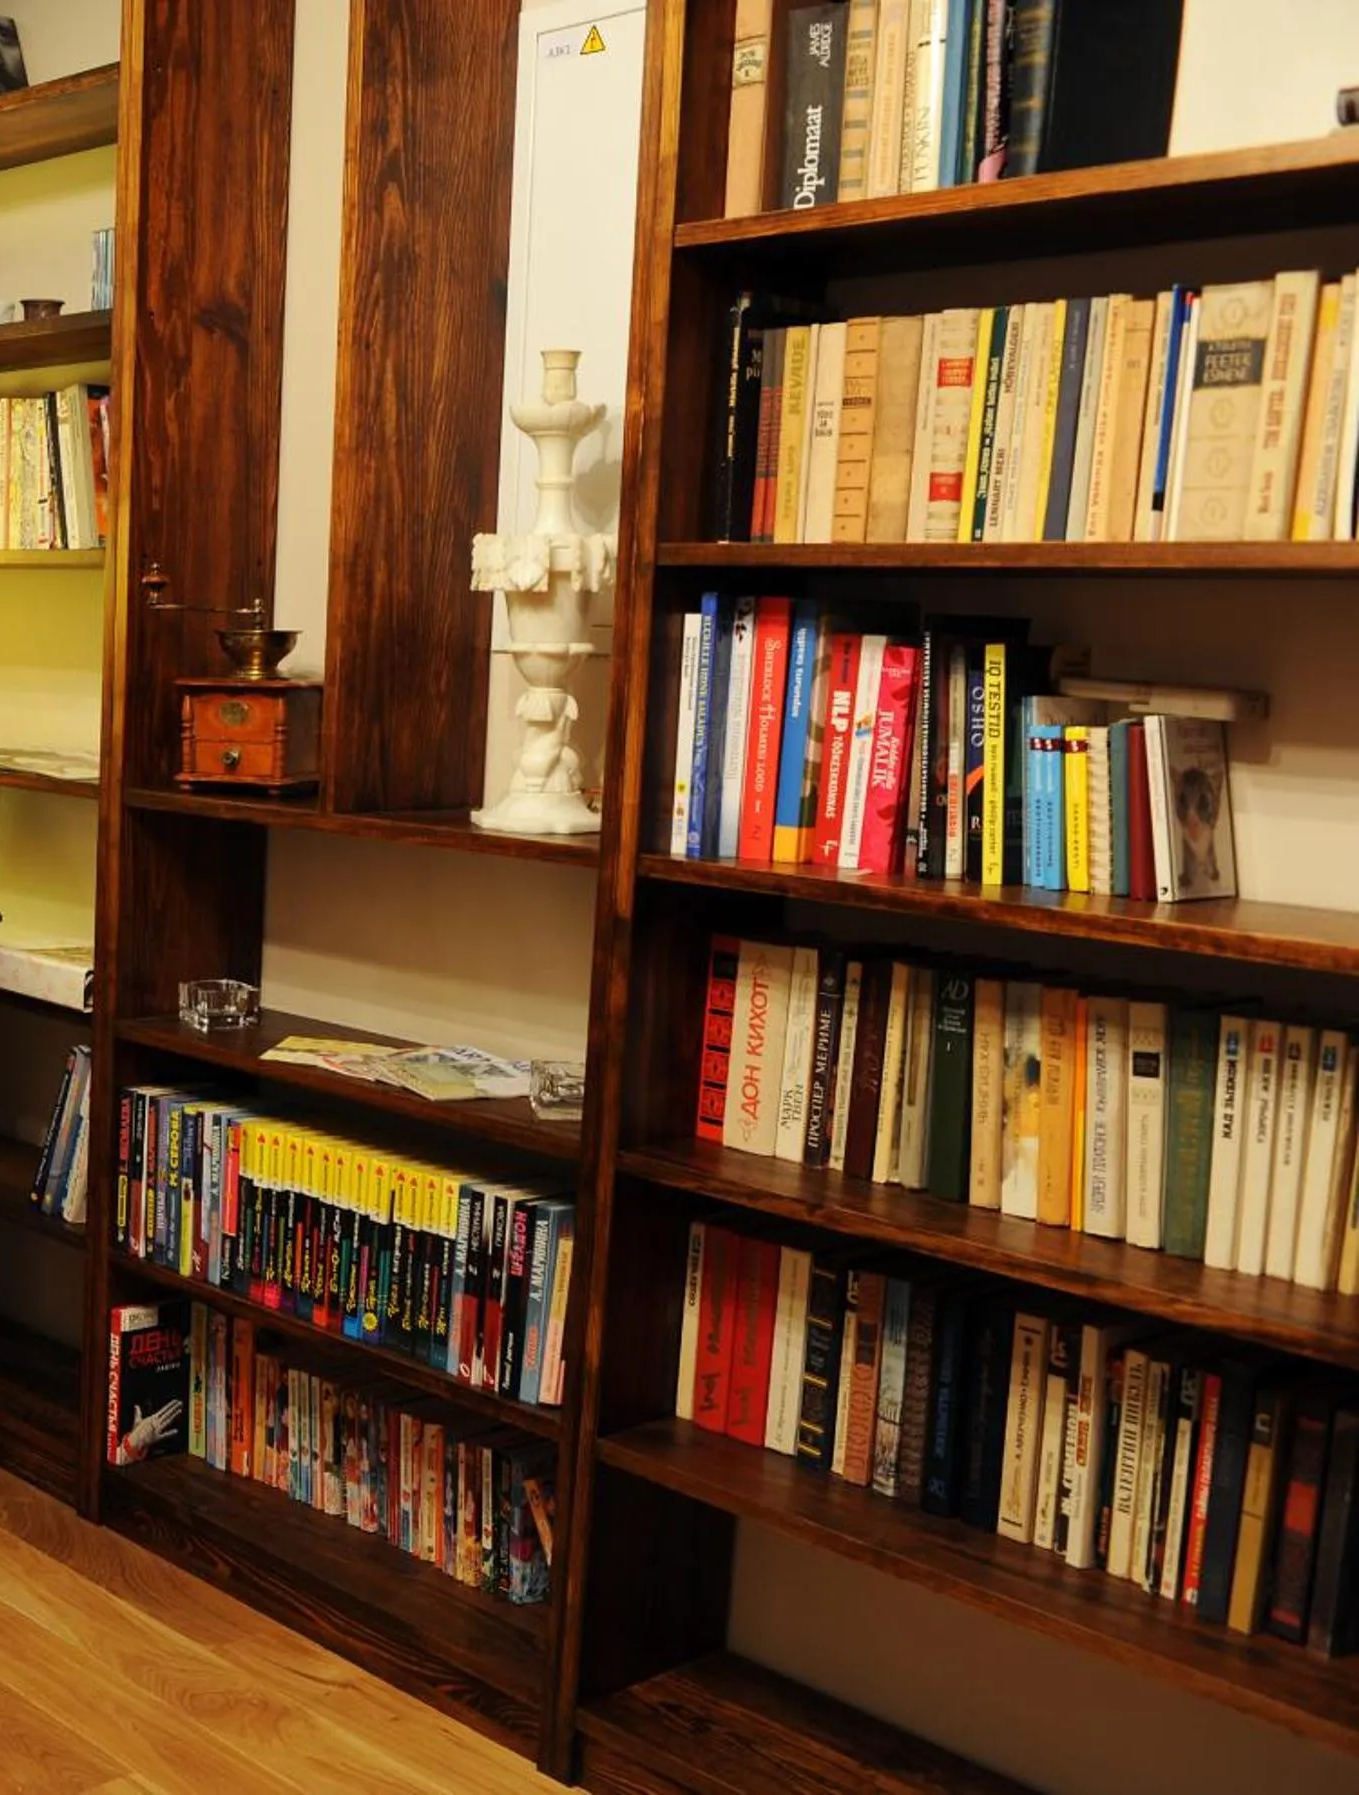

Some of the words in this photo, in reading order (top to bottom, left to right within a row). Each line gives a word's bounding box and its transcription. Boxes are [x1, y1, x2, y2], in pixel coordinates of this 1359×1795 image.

[794, 104, 825, 210] Diplomaat
[988, 660, 1001, 677] IQ
[831, 690, 851, 733] NLP
[971, 686, 984, 747] OSHO
[988, 680, 1001, 739] TESTID
[872, 710, 895, 788] JUMALIK
[747, 977, 770, 1057] КИХОТ
[816, 1009, 832, 1075] МЕРИМЕ
[742, 1065, 762, 1121] ДОН
[808, 1081, 827, 1149] ПРОСПЕР
[170, 1109, 180, 1168] СЕРОВА
[1222, 1114, 1234, 1139] НАД
[532, 1219, 550, 1288] МАРИНИНА
